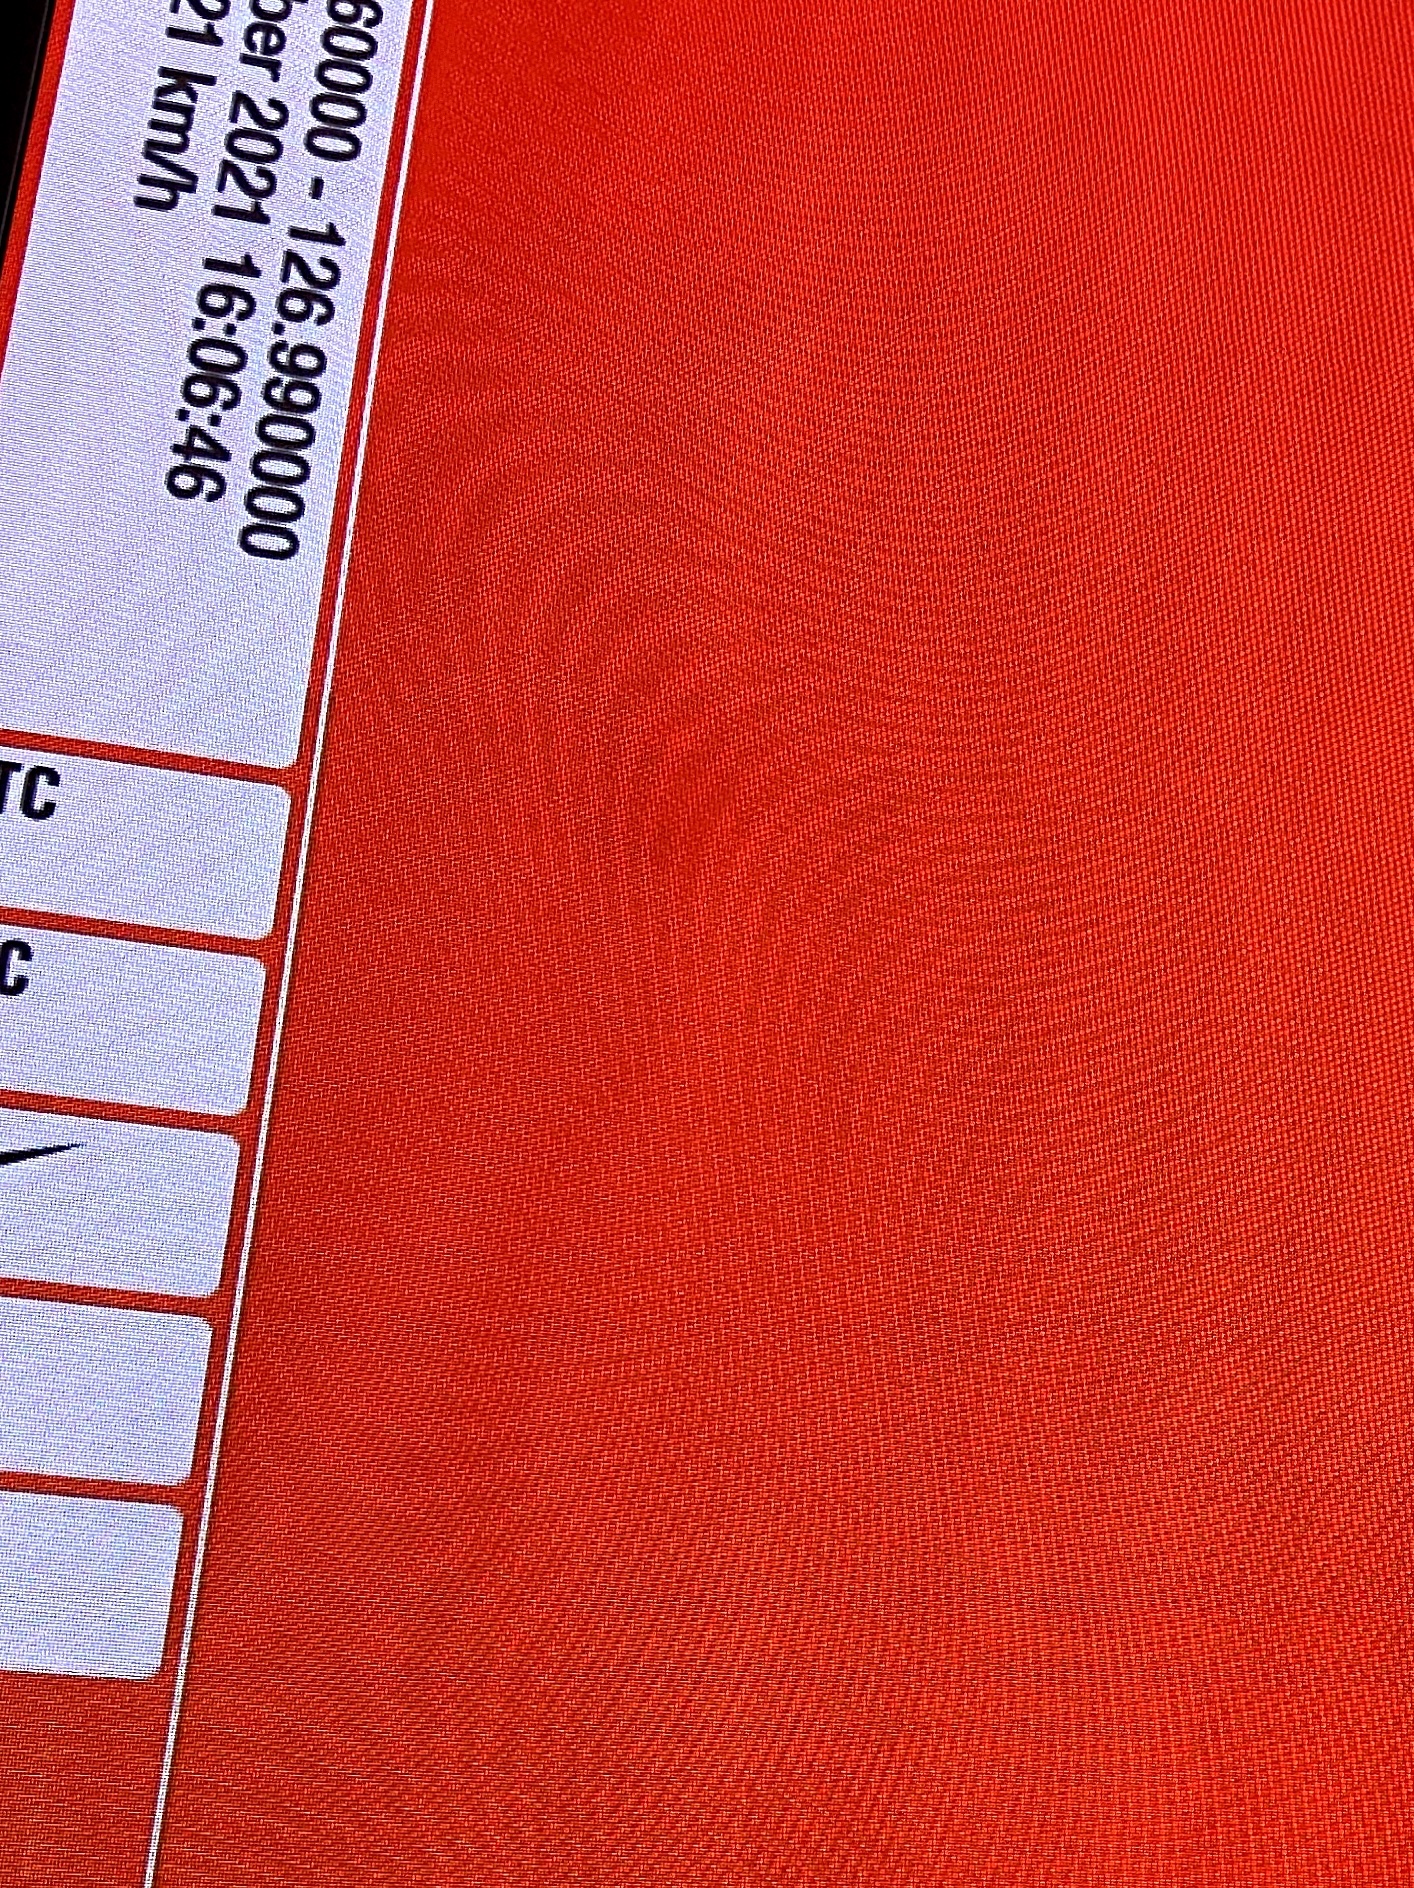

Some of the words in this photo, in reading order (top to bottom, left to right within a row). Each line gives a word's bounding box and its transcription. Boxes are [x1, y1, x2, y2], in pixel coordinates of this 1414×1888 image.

[134, 66, 217, 211] km/h
[212, 90, 289, 225] 2021
[166, 253, 261, 503] 16:06:46
[239, 222, 345, 561] 126.990000
